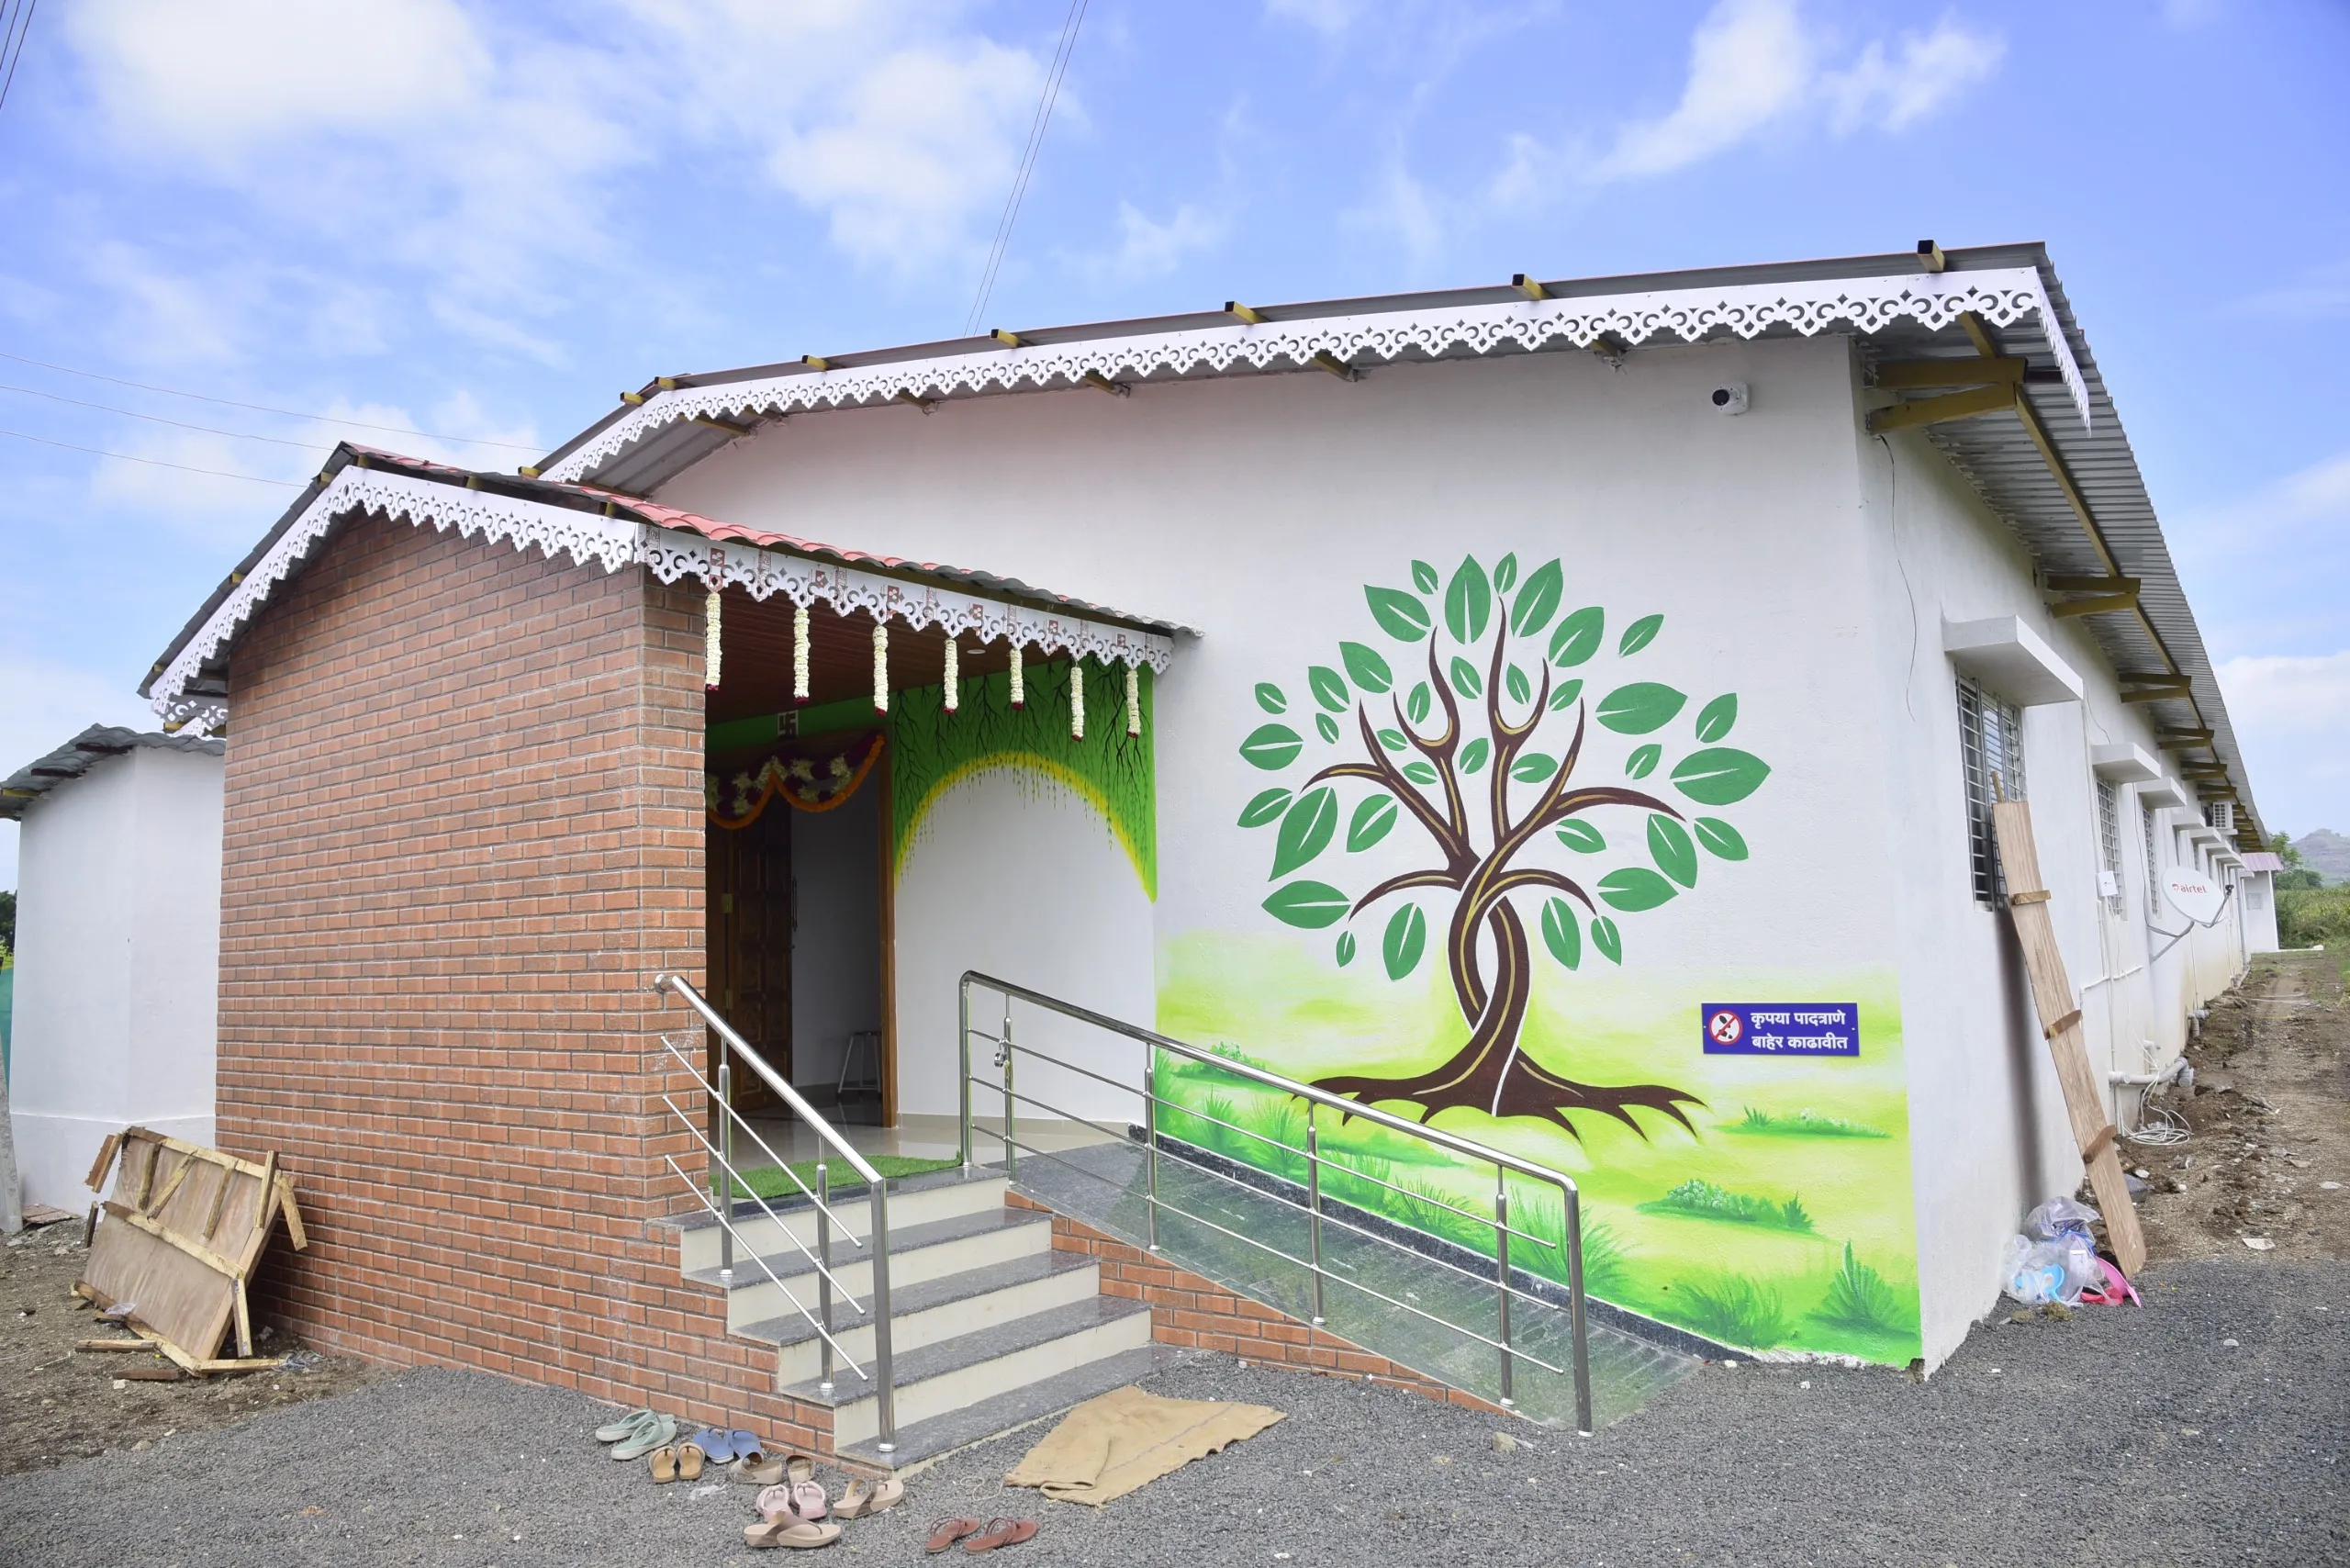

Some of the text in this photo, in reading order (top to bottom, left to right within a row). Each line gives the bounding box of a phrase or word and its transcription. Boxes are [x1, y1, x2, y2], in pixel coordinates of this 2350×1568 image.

[2180, 884, 2207, 893] airtel
[1751, 1009, 1846, 1029] कृपया पादत्राणे
[1751, 1032, 1848, 1050] बाहेर काढावीत
